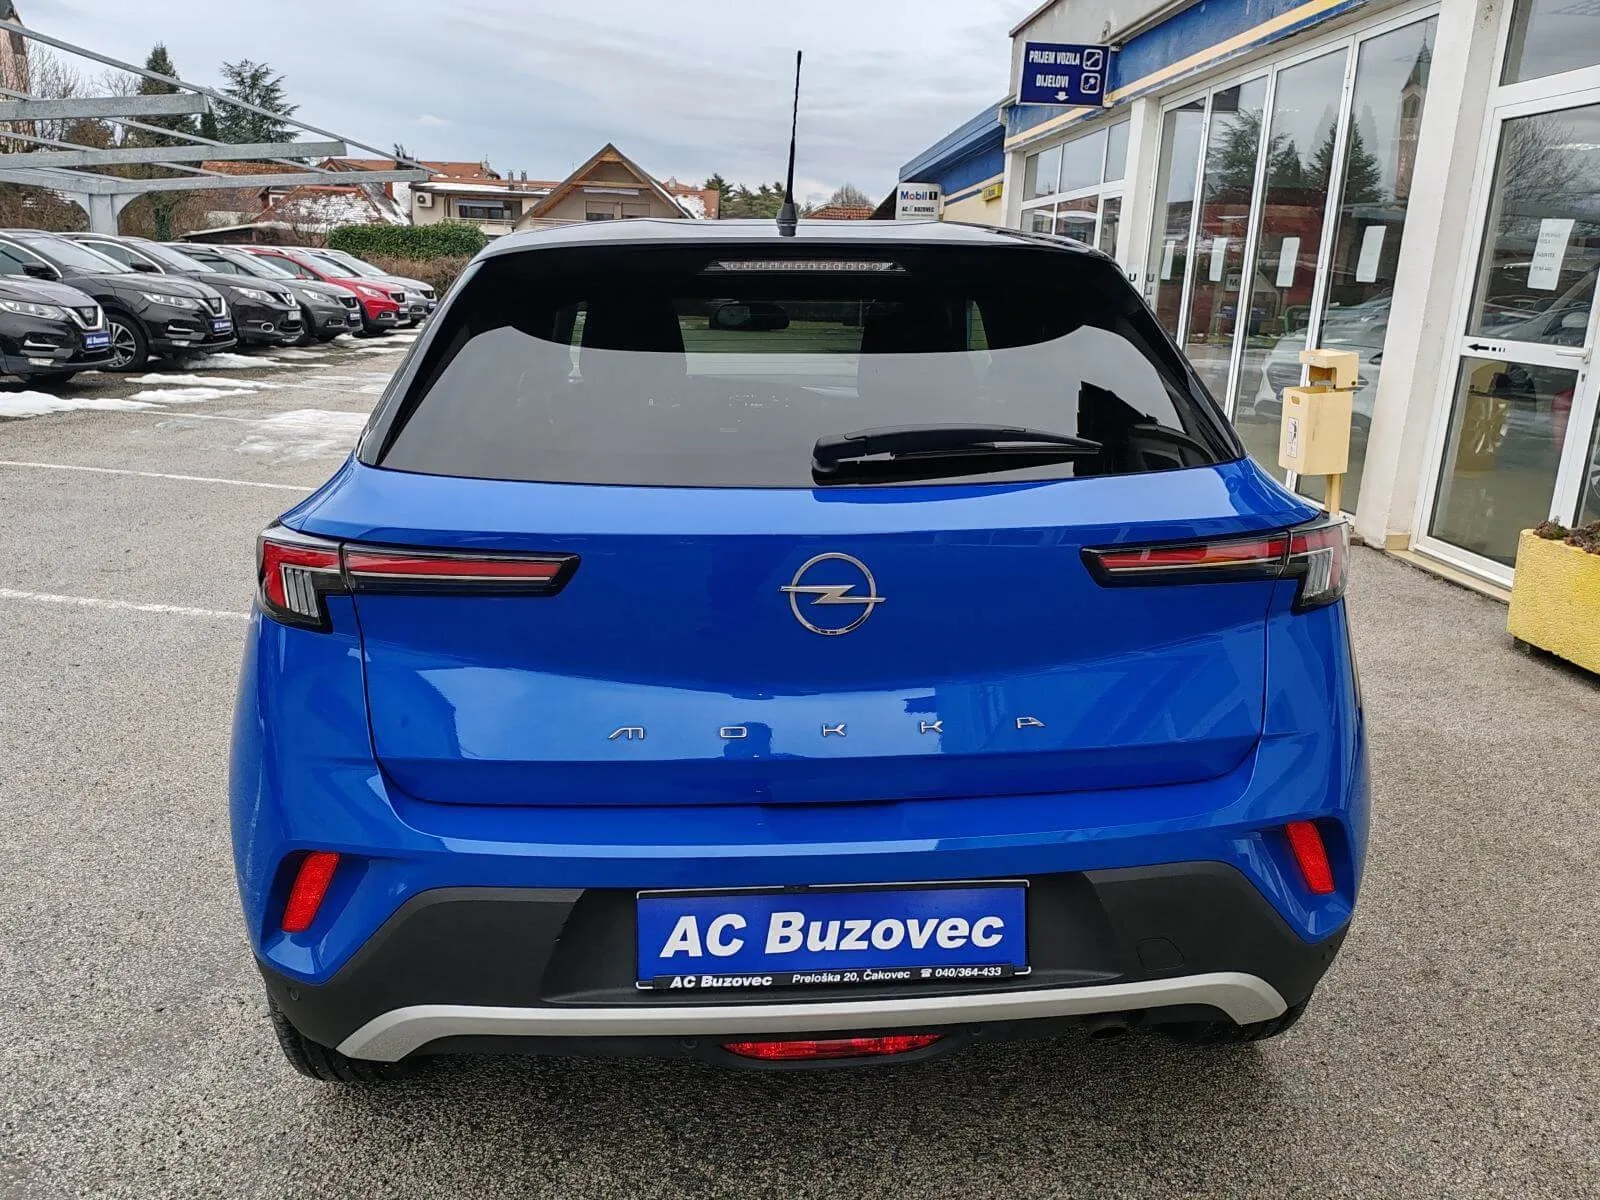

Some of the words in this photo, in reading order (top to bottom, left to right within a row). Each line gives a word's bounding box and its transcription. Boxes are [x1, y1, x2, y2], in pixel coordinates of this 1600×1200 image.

[1029, 50, 1055, 64] PRIJEM
[1056, 51, 1080, 66] VOZILA
[1035, 74, 1069, 88] DIJELOVI
[900, 191, 927, 200] Mobil
[608, 715, 1046, 740] MOKKA
[659, 913, 747, 958] AC
[765, 911, 1005, 954] Buzovec
[670, 975, 696, 989] AC
[701, 975, 773, 988] Buzovec
[792, 972, 840, 983] Preloška
[843, 972, 860, 983] 20,
[863, 968, 910, 981] Čakovec
[935, 966, 1002, 978] 040/364-433
